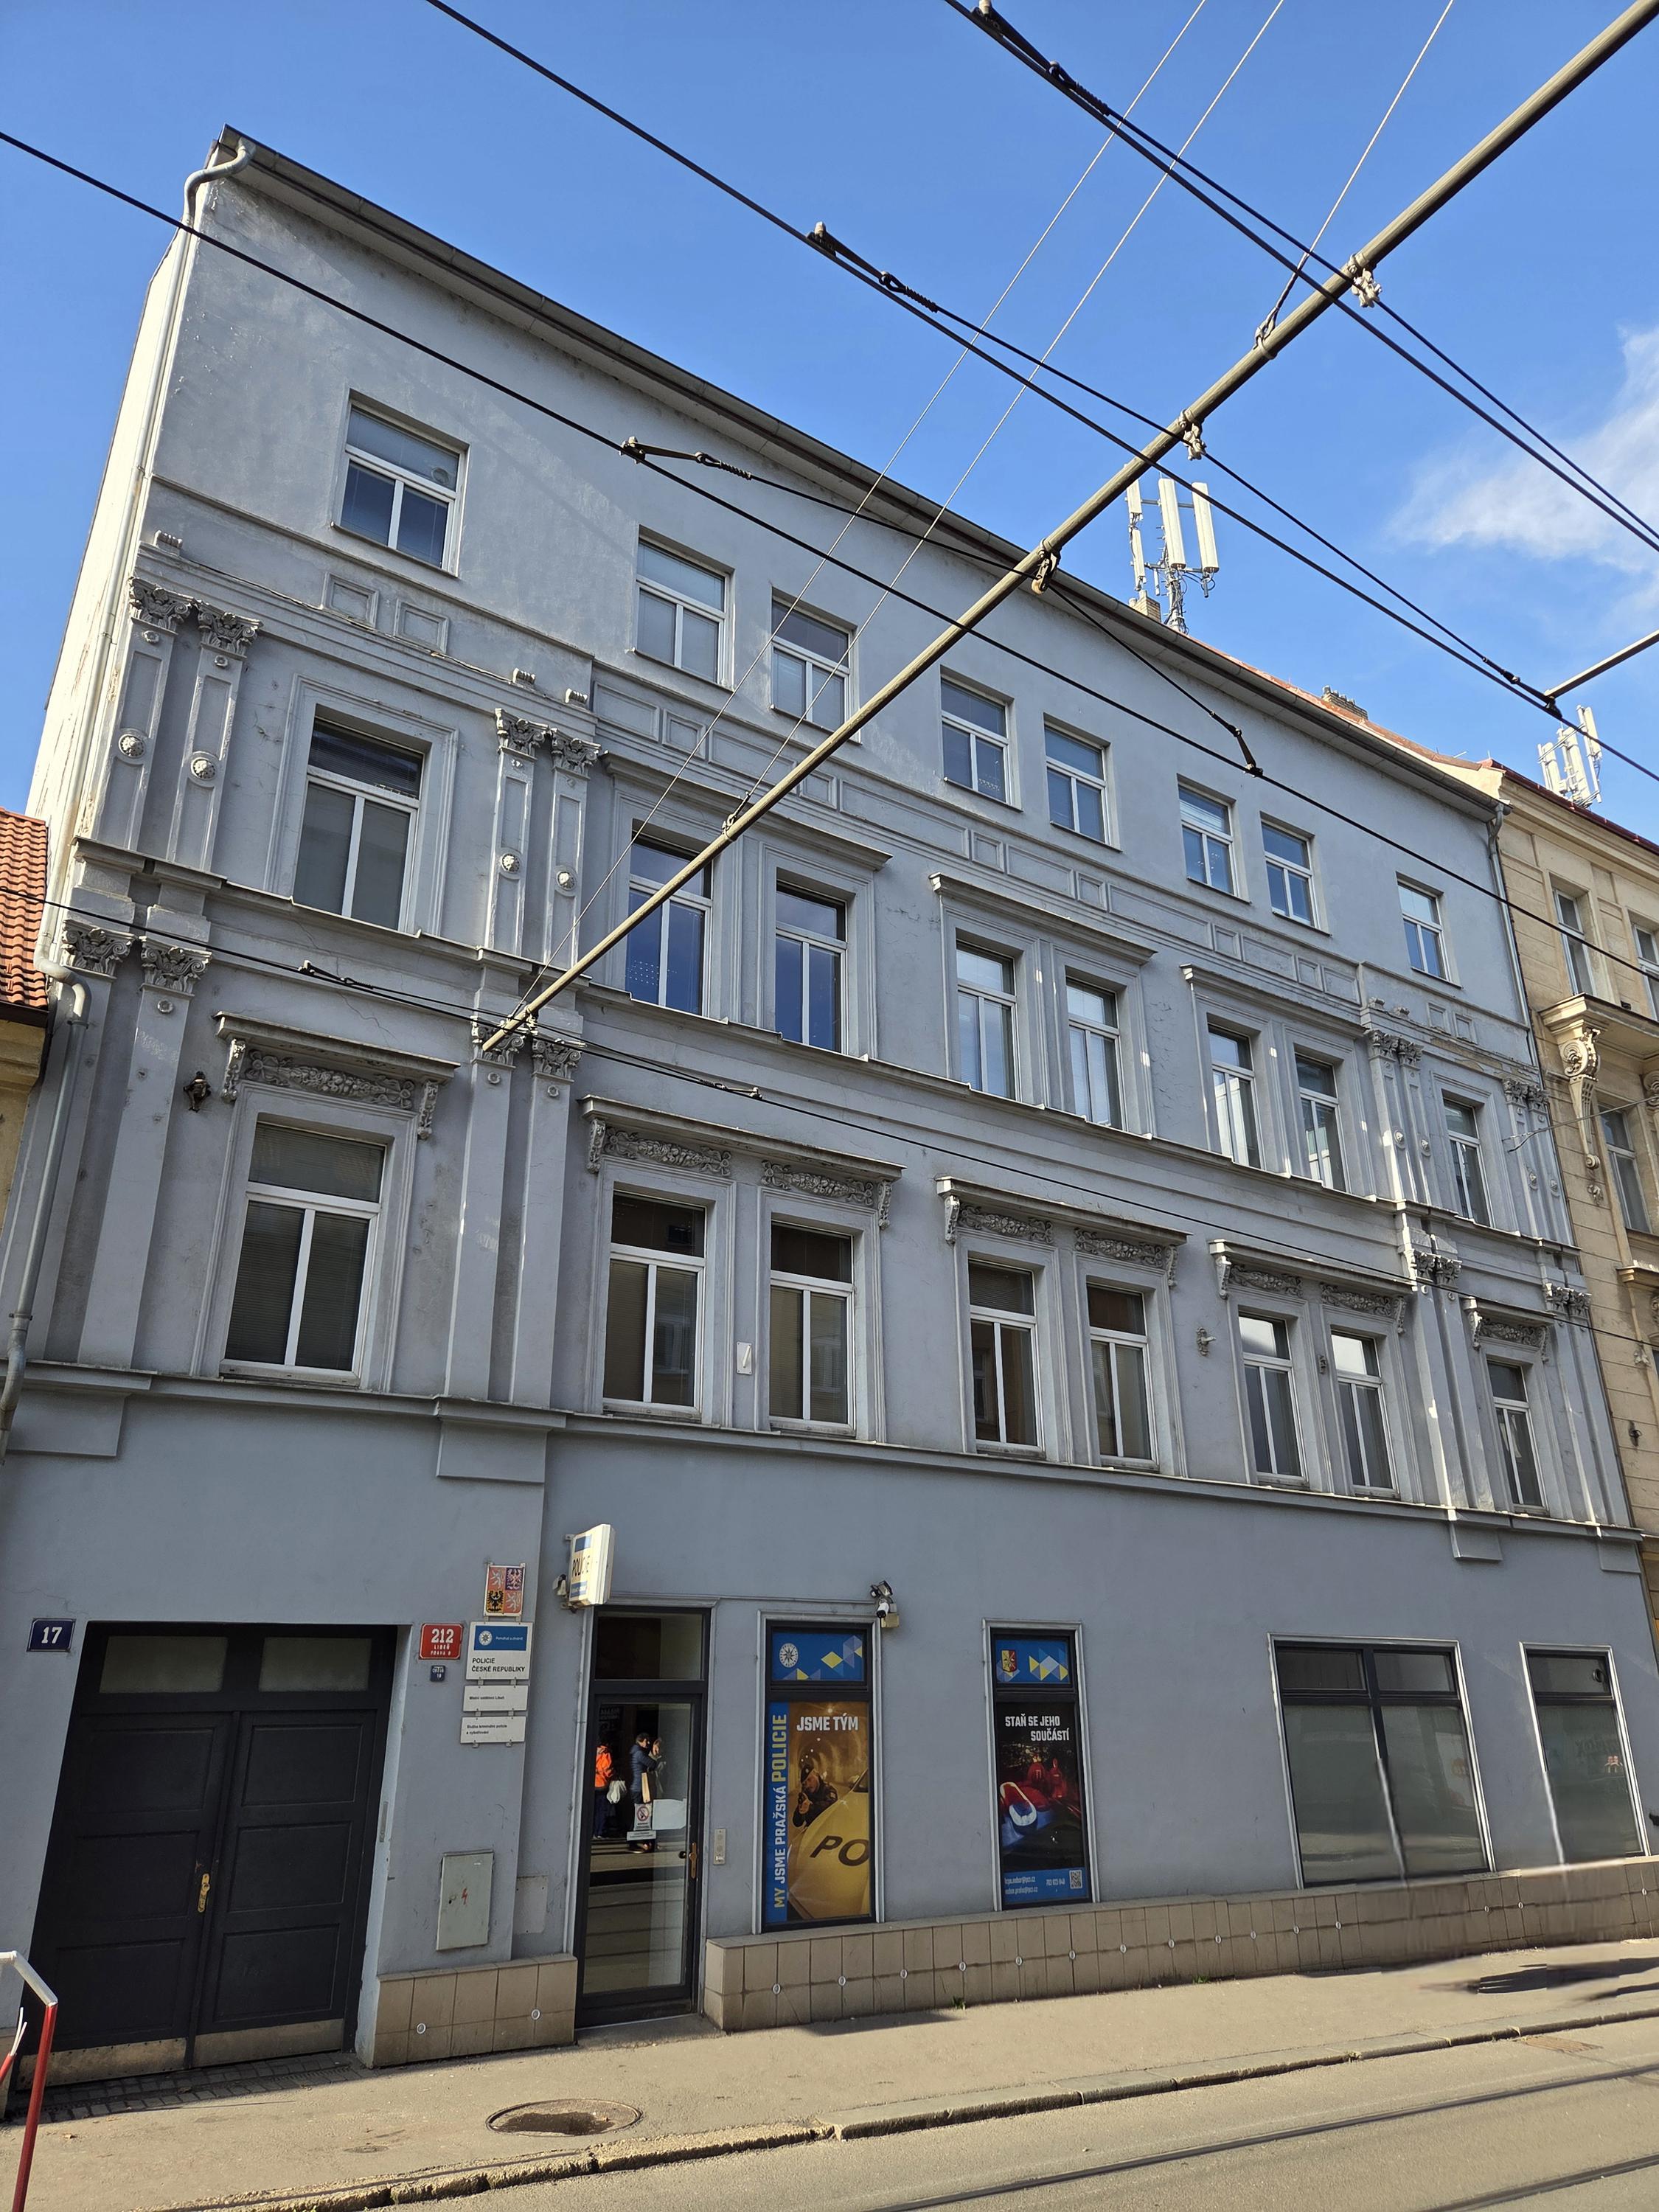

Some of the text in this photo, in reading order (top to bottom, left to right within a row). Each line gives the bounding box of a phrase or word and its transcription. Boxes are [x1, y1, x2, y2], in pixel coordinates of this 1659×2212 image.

[41, 1627, 63, 1644] 17
[431, 1628, 454, 1644] 212
[796, 1712, 858, 1731] JSME TÝM
[1005, 1713, 1060, 1727] STAŇ SE JEHO
[1031, 1728, 1069, 1741] SOUČÁSTÍ
[771, 1714, 787, 1908] MY JSME PRAŽSKÁ POLICIE
[809, 1835, 869, 1866] PO
